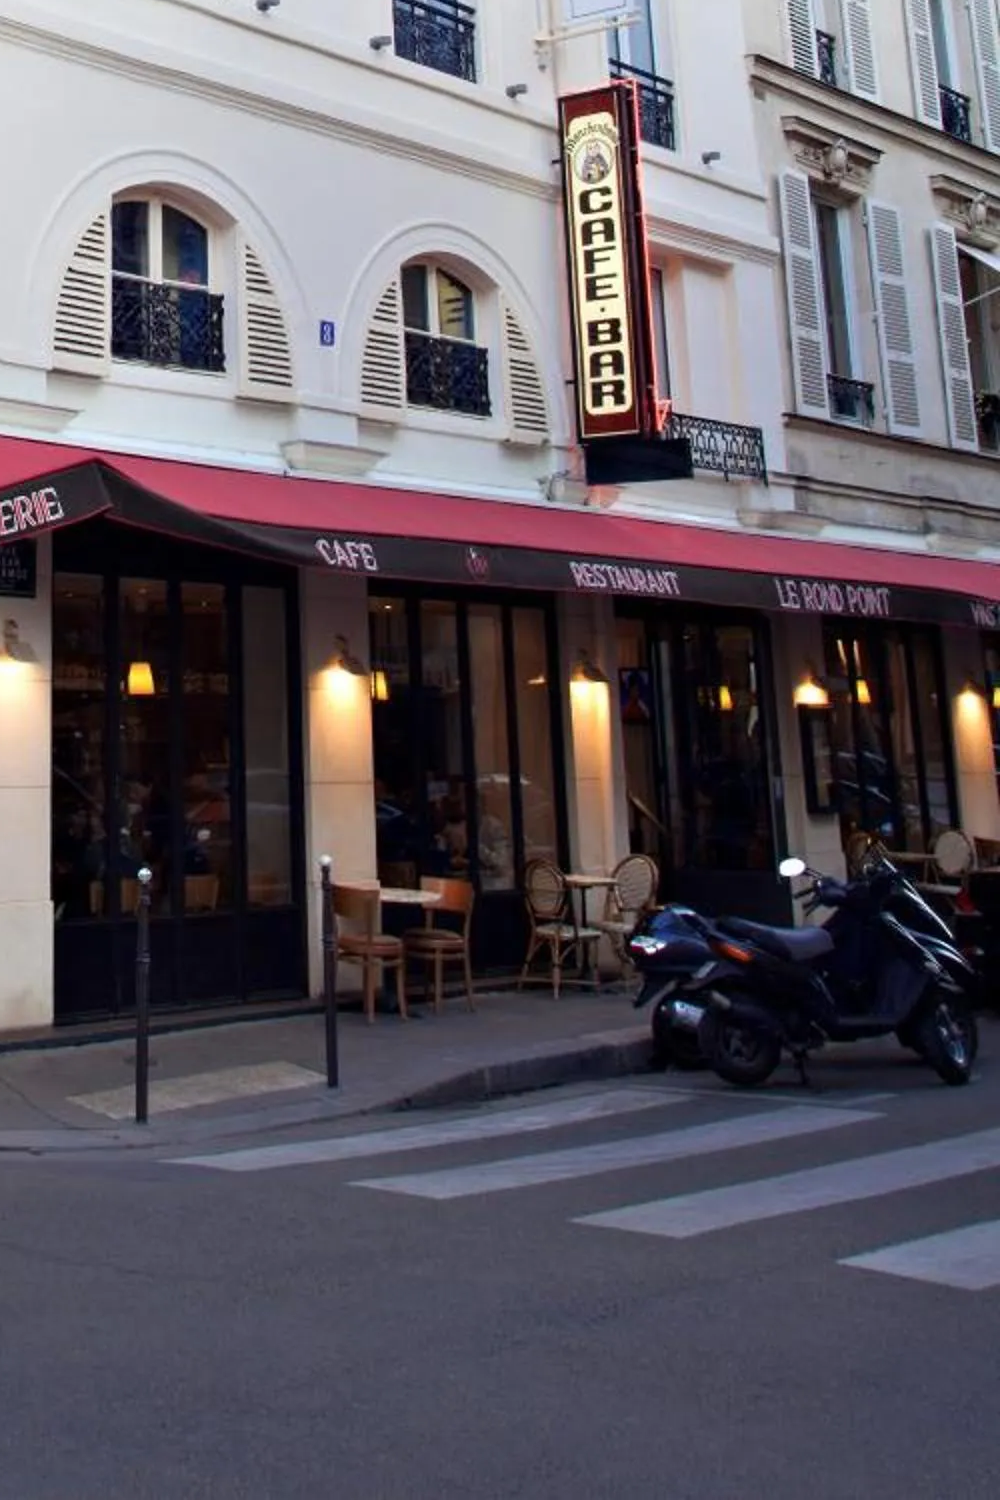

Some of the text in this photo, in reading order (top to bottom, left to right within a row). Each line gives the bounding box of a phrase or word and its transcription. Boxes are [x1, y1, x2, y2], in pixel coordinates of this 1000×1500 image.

[587, 318, 626, 408] BAR
[569, 561, 680, 595] RESTAURANT
[774, 578, 891, 615] LE ROND POINT
